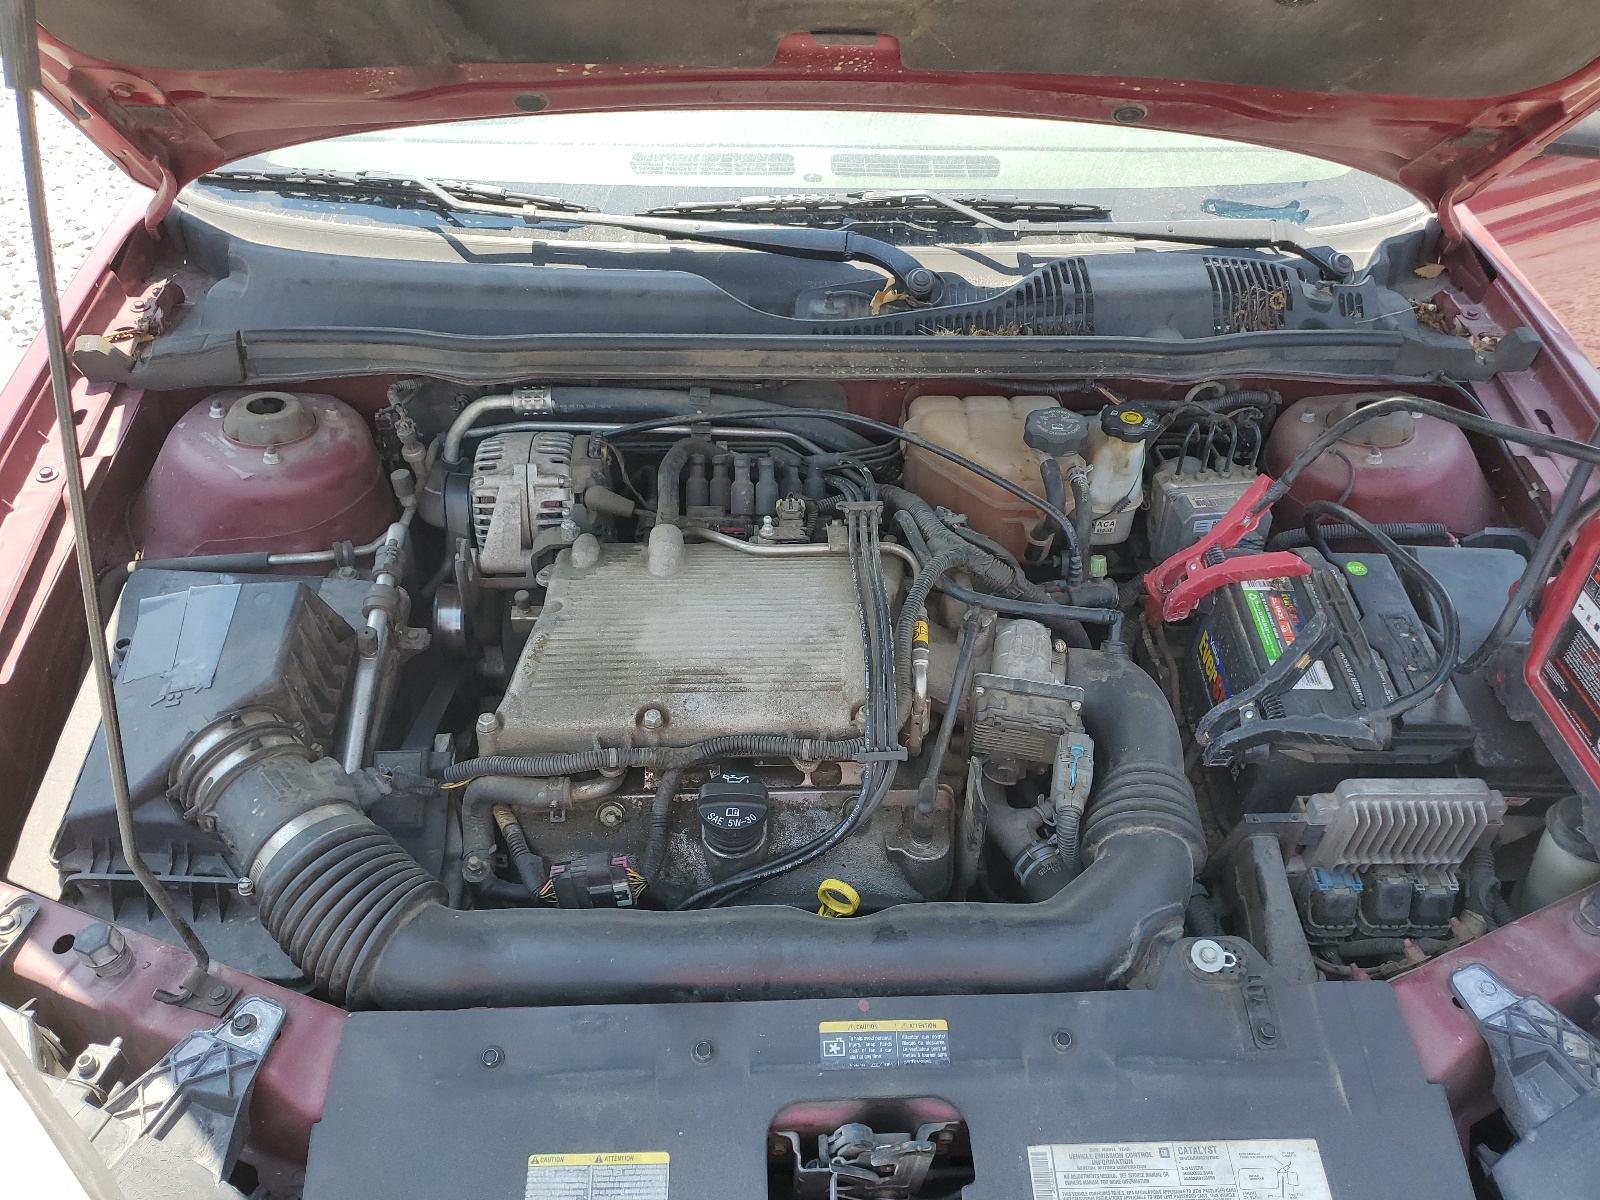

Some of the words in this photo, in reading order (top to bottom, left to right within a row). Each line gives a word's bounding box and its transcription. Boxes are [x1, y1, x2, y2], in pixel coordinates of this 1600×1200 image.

[707, 812, 725, 826] SAE
[727, 813, 757, 827] 5W-30
[1178, 1146, 1217, 1154] CATALYST
